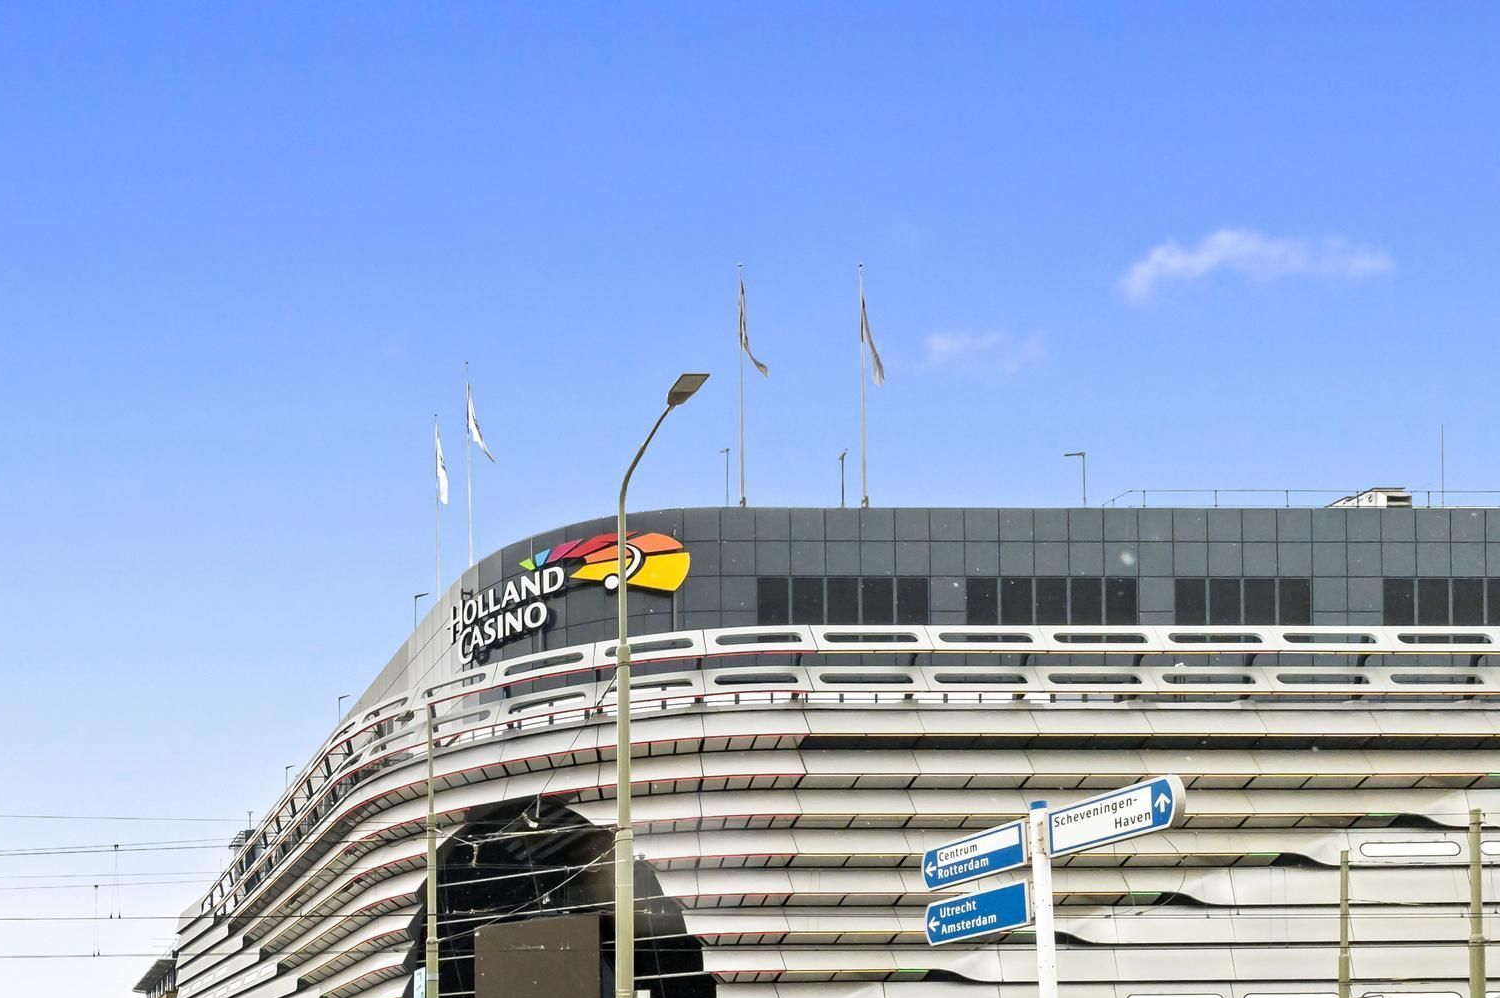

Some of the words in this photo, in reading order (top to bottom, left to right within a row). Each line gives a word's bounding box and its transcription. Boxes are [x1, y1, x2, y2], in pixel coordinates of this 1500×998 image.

[447, 566, 565, 645] HOLLAND
[457, 601, 548, 665] CASINO
[1053, 796, 1138, 828] Scheveningen-
[1114, 811, 1151, 830] Haven
[938, 843, 978, 862] Centrum
[937, 856, 989, 880] Rotterdam
[939, 899, 977, 919] Utrecht
[941, 913, 997, 935] Amsterdam
